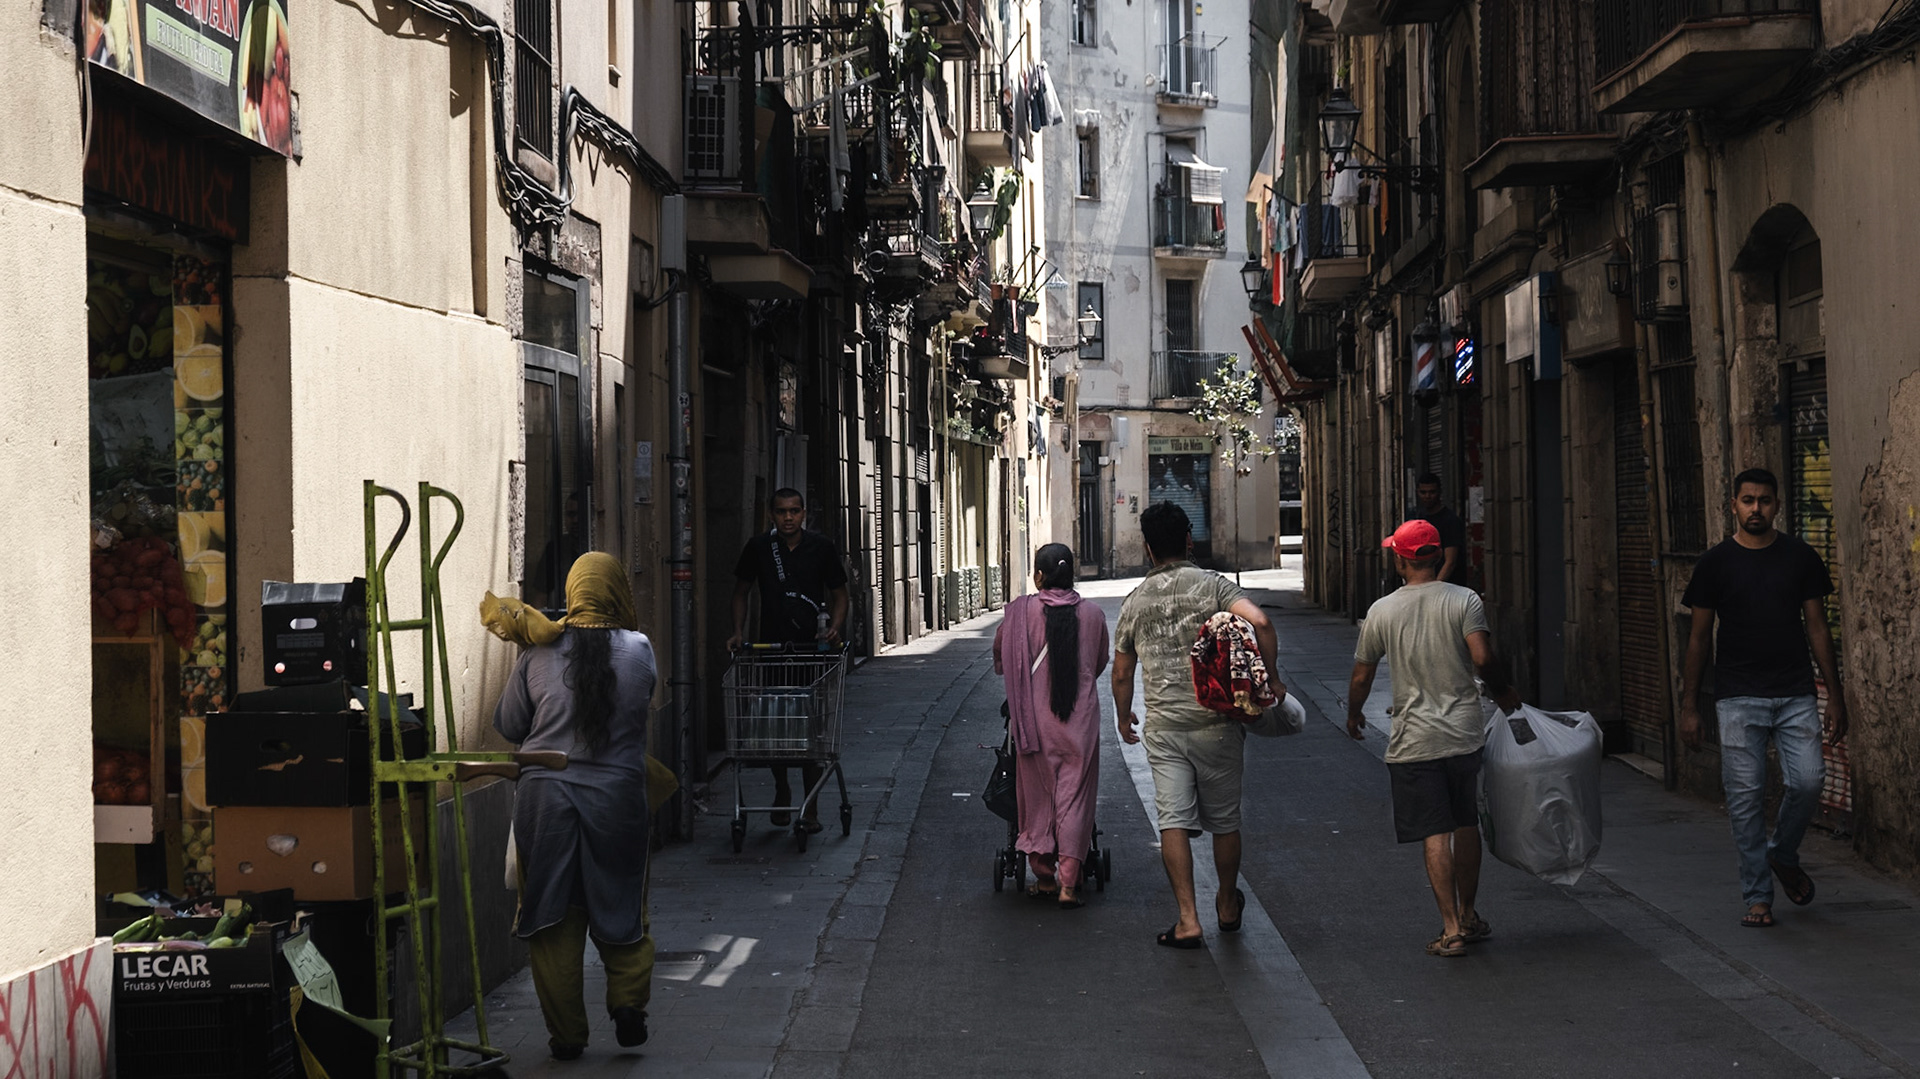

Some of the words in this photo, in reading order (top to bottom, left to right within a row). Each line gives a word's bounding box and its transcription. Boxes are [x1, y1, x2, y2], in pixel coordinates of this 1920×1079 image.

[1170, 439, 1182, 451] Villa
[1183, 439, 1189, 451] de
[121, 954, 210, 979] LECAR
[123, 980, 156, 991] Frutas
[158, 982, 164, 992] y
[165, 978, 211, 990] Verduras
